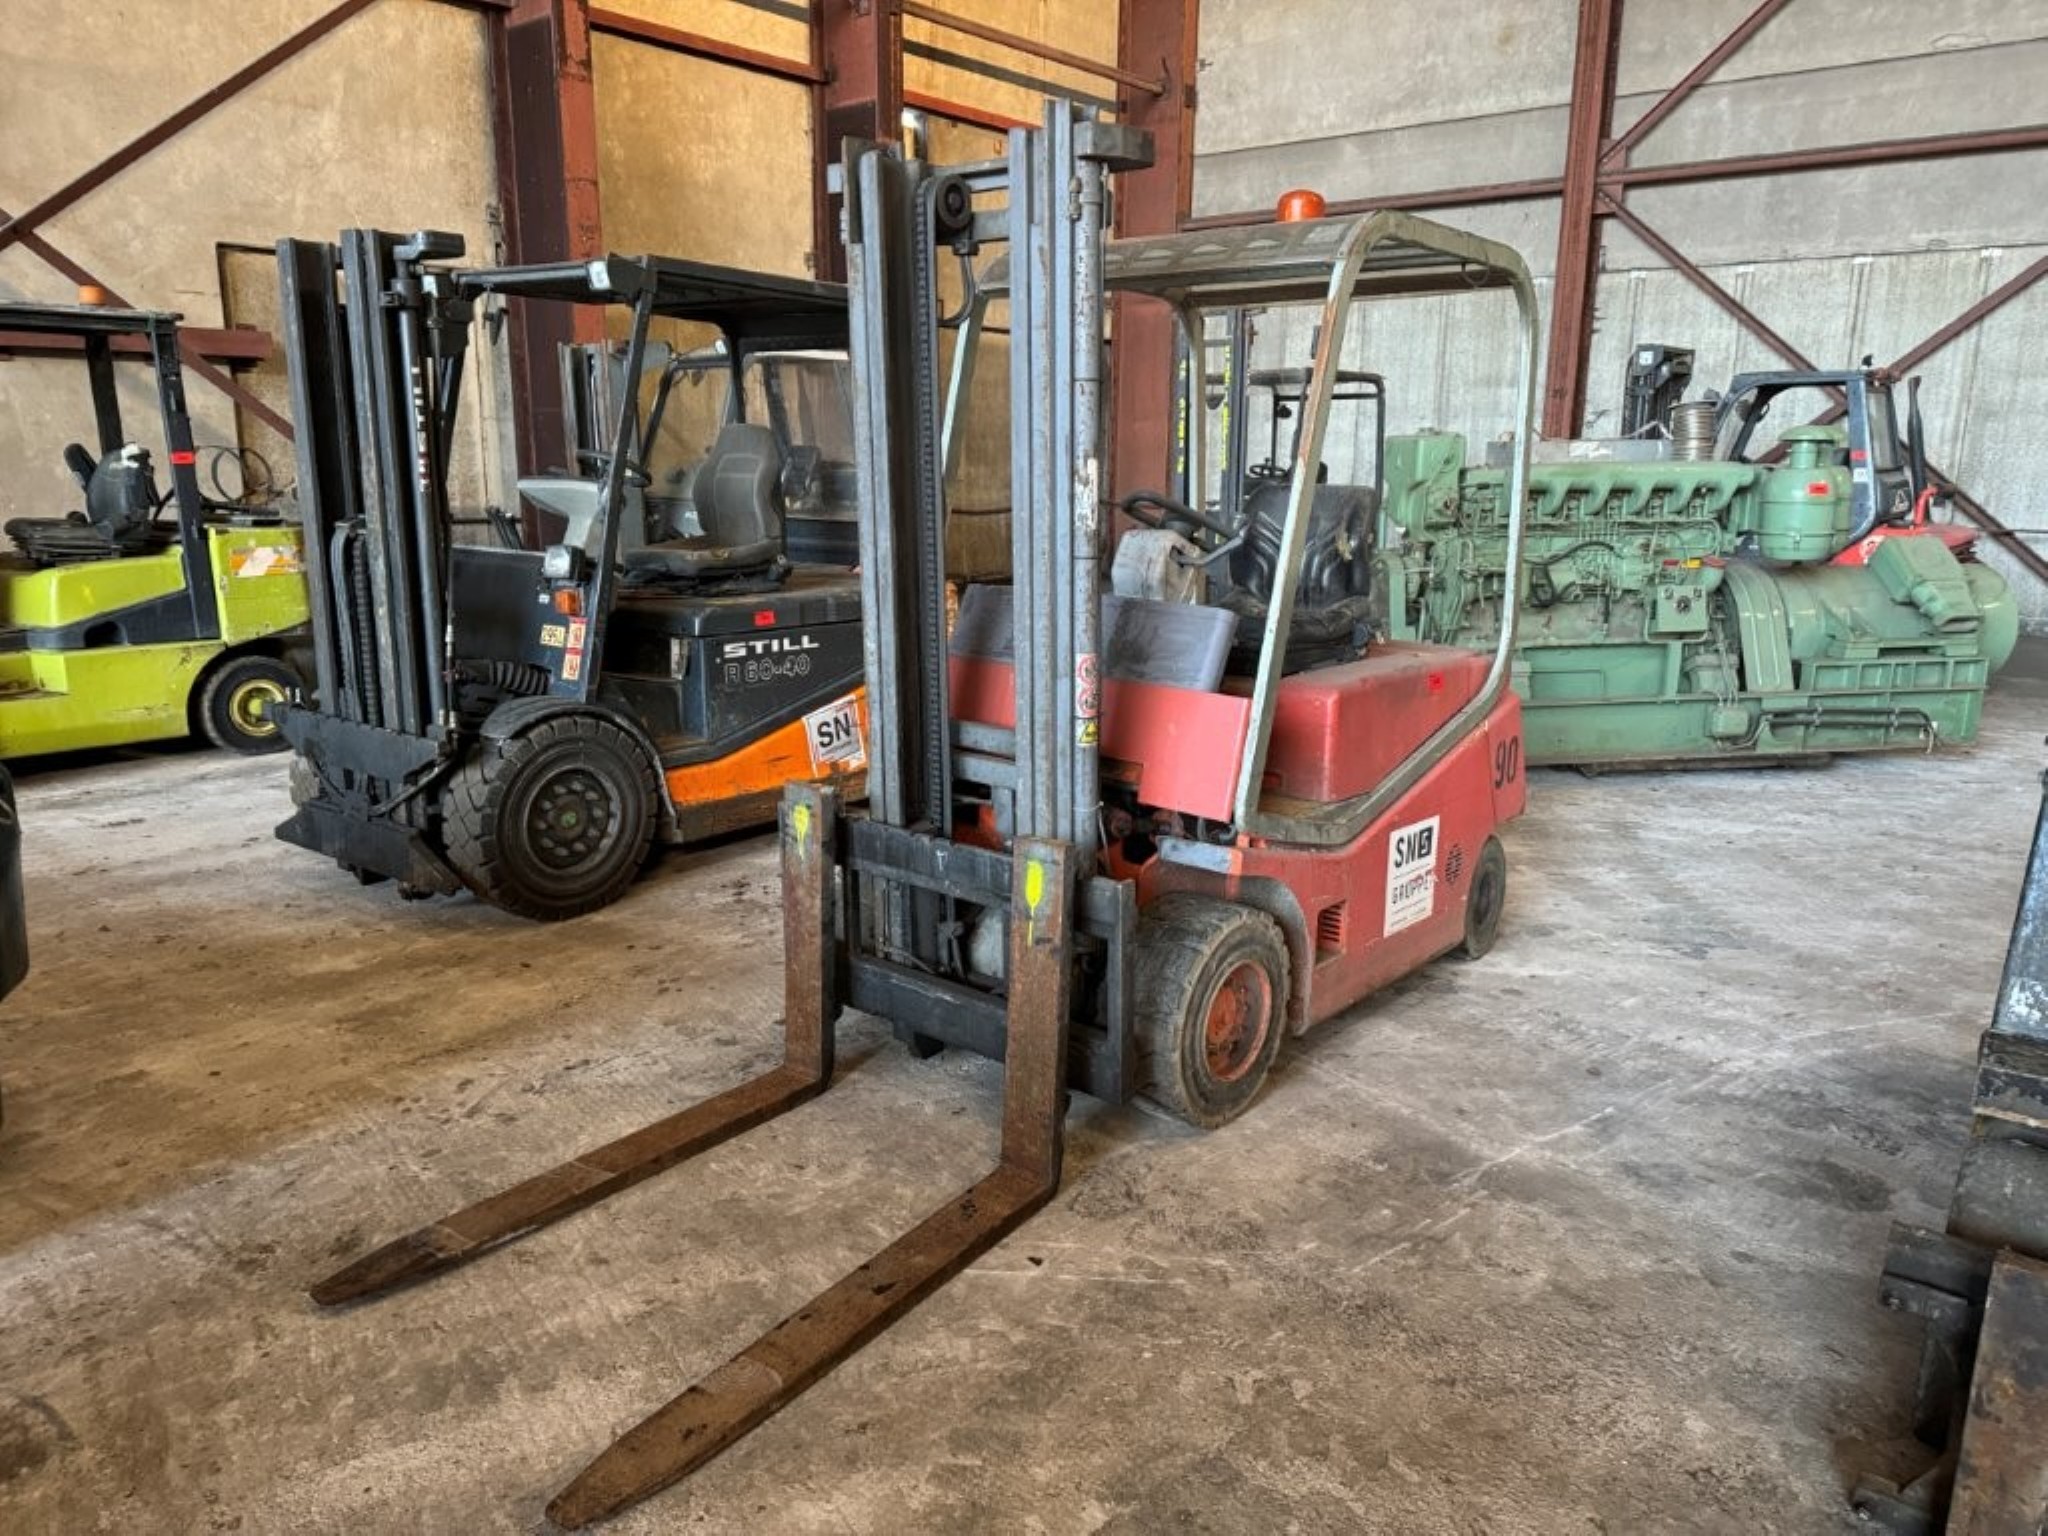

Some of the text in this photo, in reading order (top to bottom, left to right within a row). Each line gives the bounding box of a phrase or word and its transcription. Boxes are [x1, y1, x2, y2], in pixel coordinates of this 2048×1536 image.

[723, 635, 820, 659] STILL
[817, 713, 851, 748] SN
[1495, 735, 1519, 789] 90
